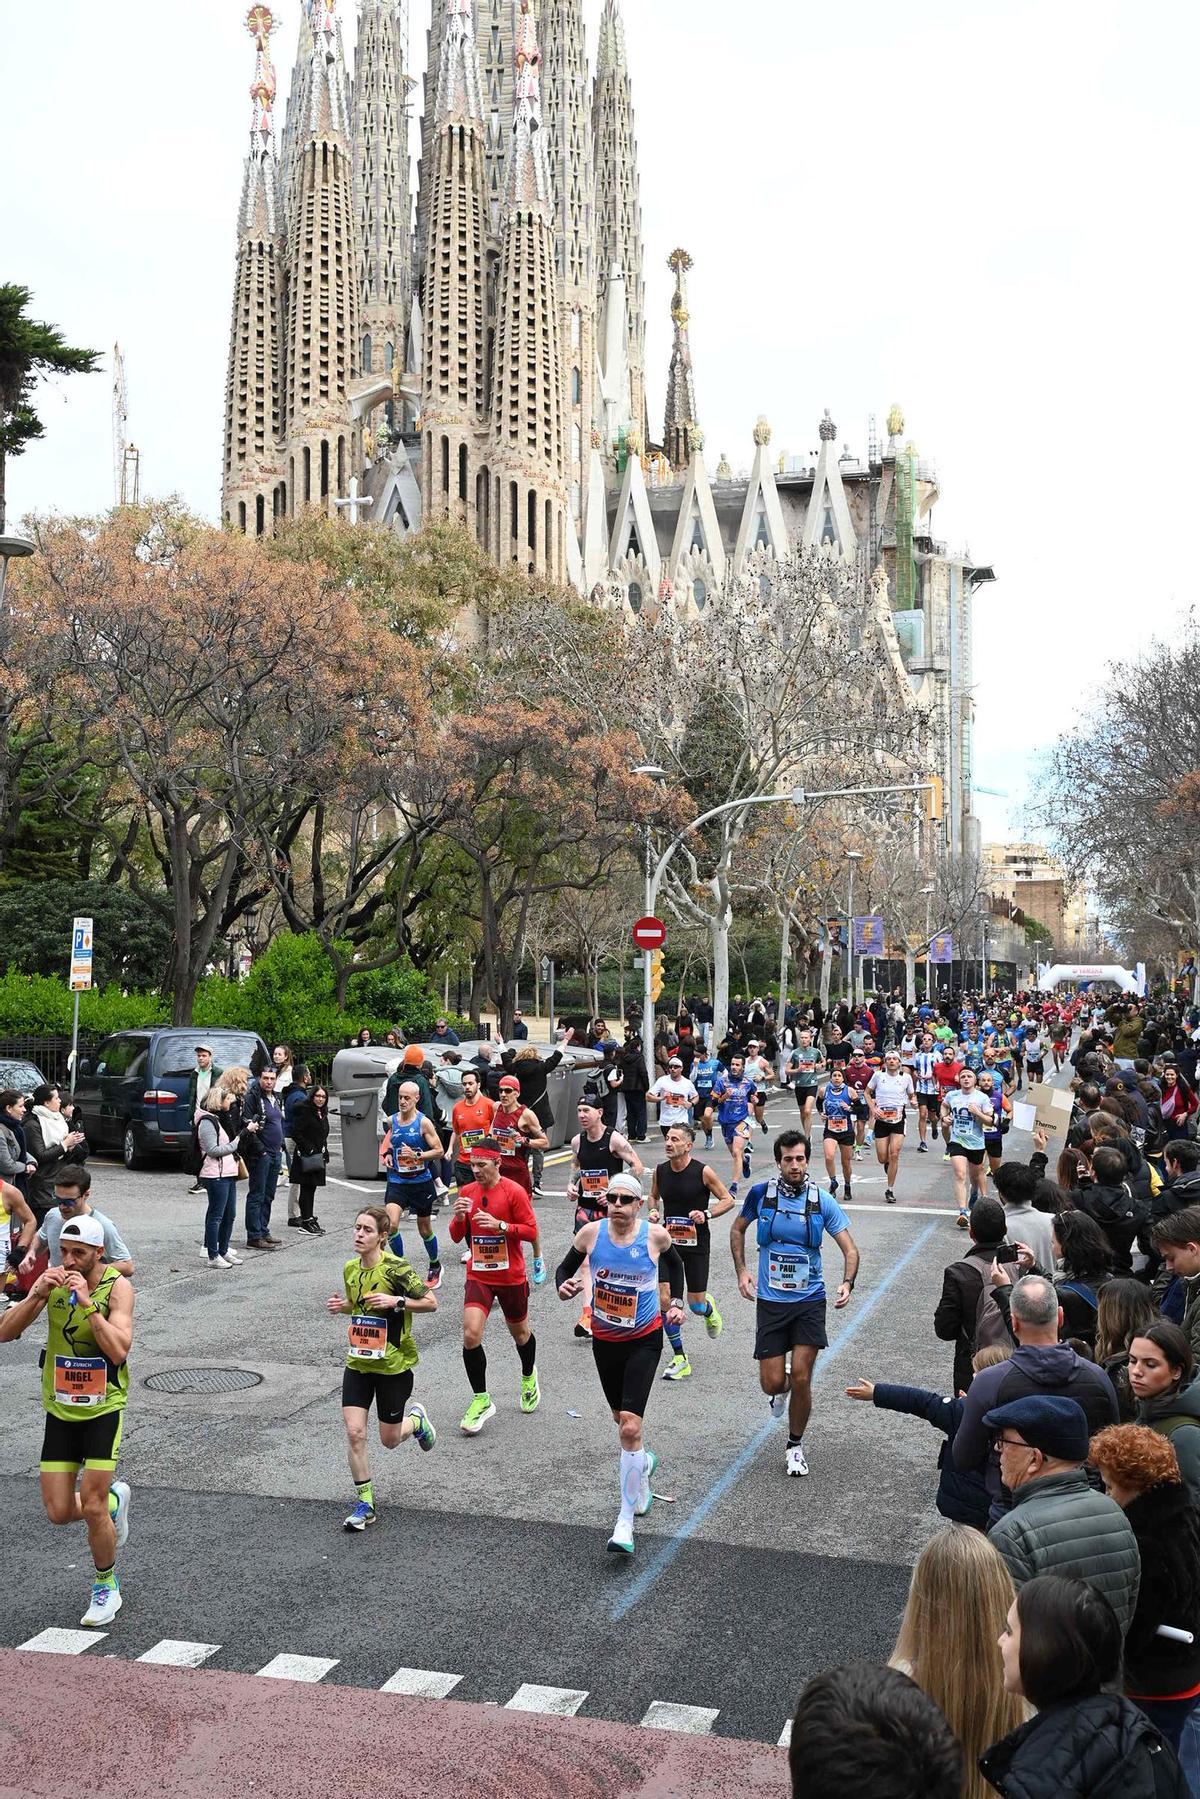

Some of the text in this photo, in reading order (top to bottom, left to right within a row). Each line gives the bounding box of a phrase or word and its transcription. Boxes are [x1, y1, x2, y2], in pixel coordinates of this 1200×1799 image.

[76, 932, 82, 948] P
[1035, 1120, 1057, 1130] Thermo
[479, 1246, 500, 1254] SERGIO
[779, 1264, 797, 1273] PAUL
[597, 1290, 633, 1307] MATTHIAS
[352, 1327, 380, 1338] PALOMA
[65, 1371, 93, 1382] ANGEL
